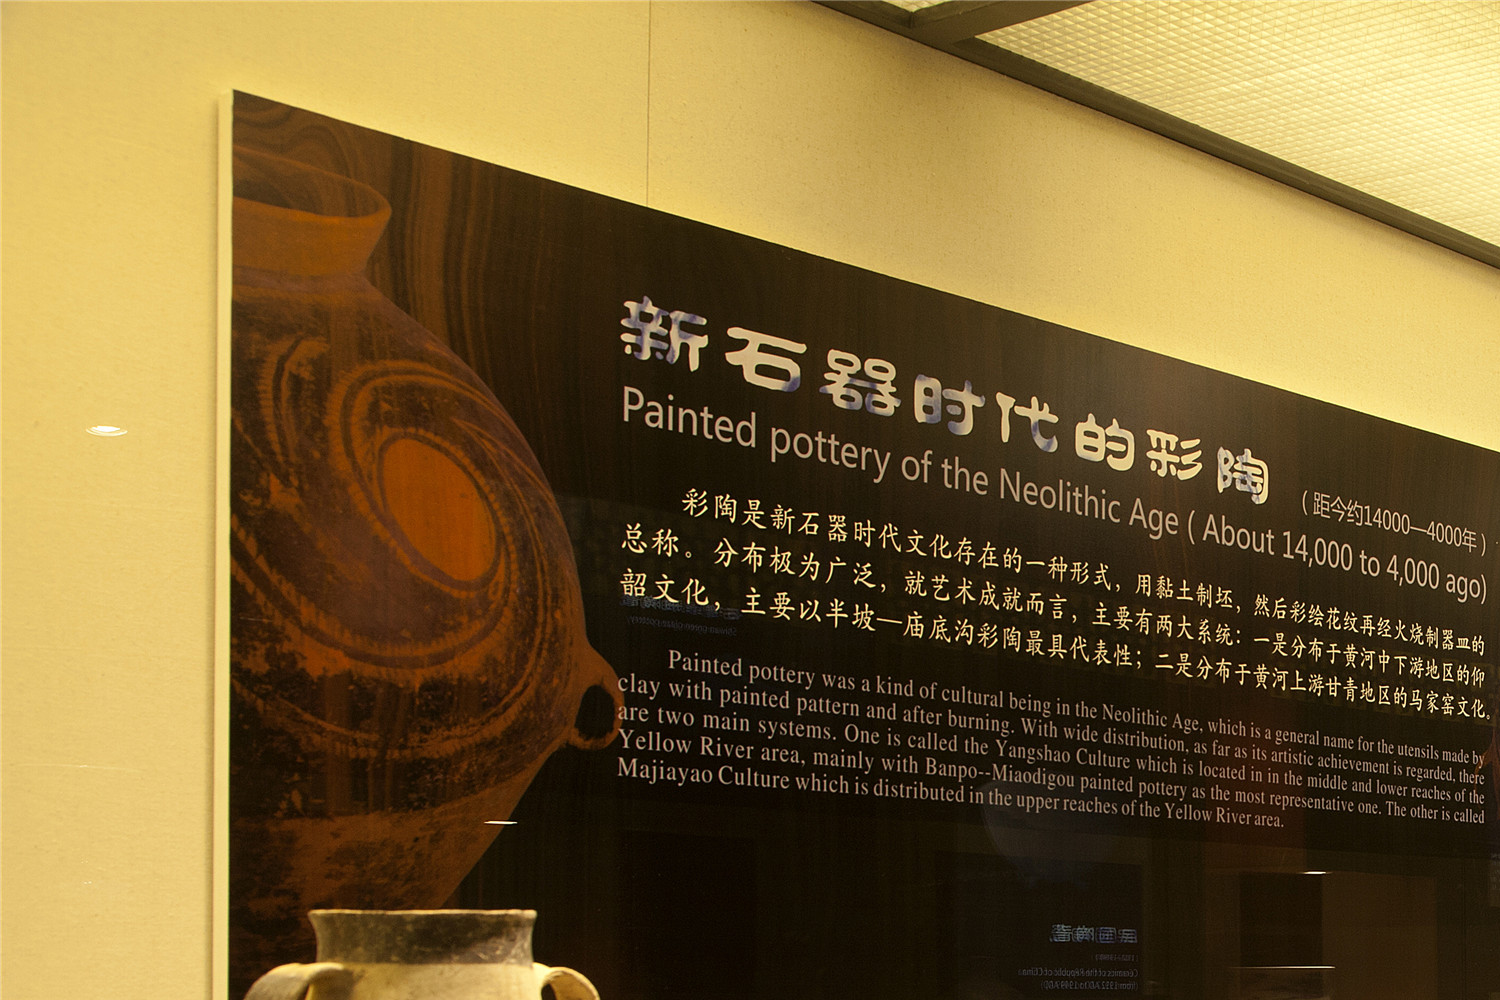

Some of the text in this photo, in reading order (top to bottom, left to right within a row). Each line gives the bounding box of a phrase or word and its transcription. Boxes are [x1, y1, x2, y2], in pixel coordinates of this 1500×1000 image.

[620, 296, 1269, 504] 新石器时代的彩陶
[624, 386, 755, 447] Painted
[771, 428, 890, 483] pottery
[902, 450, 932, 483] of
[942, 457, 988, 495] the
[1001, 468, 1120, 523] Neolithic
[1129, 498, 1178, 539] Age
[1203, 514, 1274, 555] About
[1283, 531, 1352, 571] 14,000
[1360, 550, 1380, 576] to
[1387, 555, 1439, 589] 4,000
[1446, 574, 1486, 604] ago)
[618, 673, 1484, 784] clay with painted pattern and after burning. With wide distribution, as far as its artistic achievement is regarded, there
[618, 706, 1484, 804] are two main systems. One is called the Yangshao Culture which is located in in the middle and lower reaches of the
[669, 650, 1484, 769] Painted pottery was a kind of cultural being in the Neolithic Age, which is a general name for the utensils made by
[618, 729, 1484, 824] Yellow River area, mainly with Banpo--Miaodigou painted pottery as the most representative one. The other is called
[618, 757, 1284, 827] Majiayao Culture which is distributed in the upper reaches of the Yellow River area.
